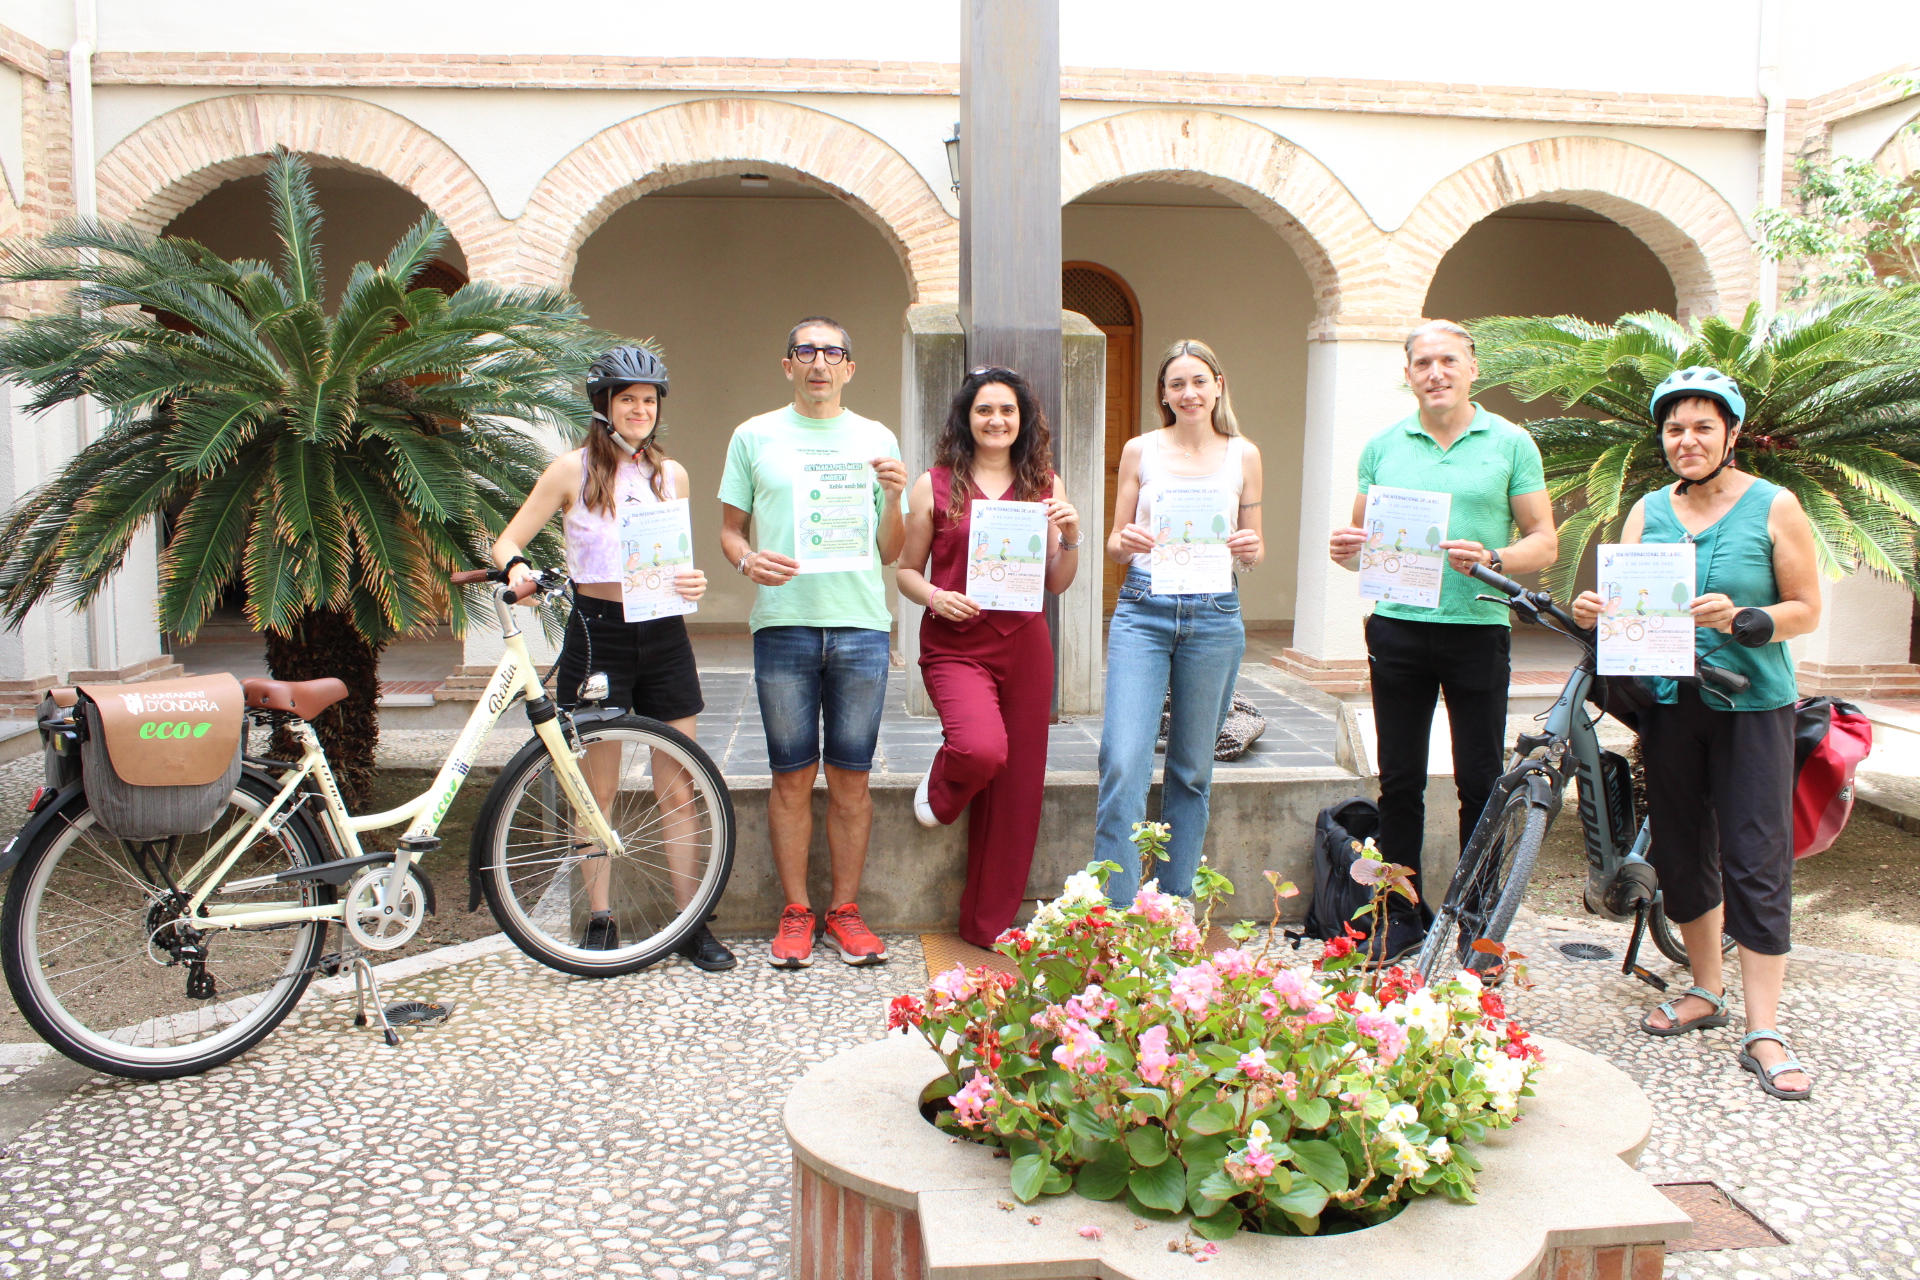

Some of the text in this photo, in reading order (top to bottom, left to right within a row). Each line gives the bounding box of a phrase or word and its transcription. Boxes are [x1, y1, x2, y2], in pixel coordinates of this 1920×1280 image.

[144, 690, 206, 700] AJUNTAMENT
[489, 664, 517, 715] Berlin
[146, 700, 220, 712] D'ONDARA
[140, 722, 191, 740] eco
[432, 790, 452, 824] eco
